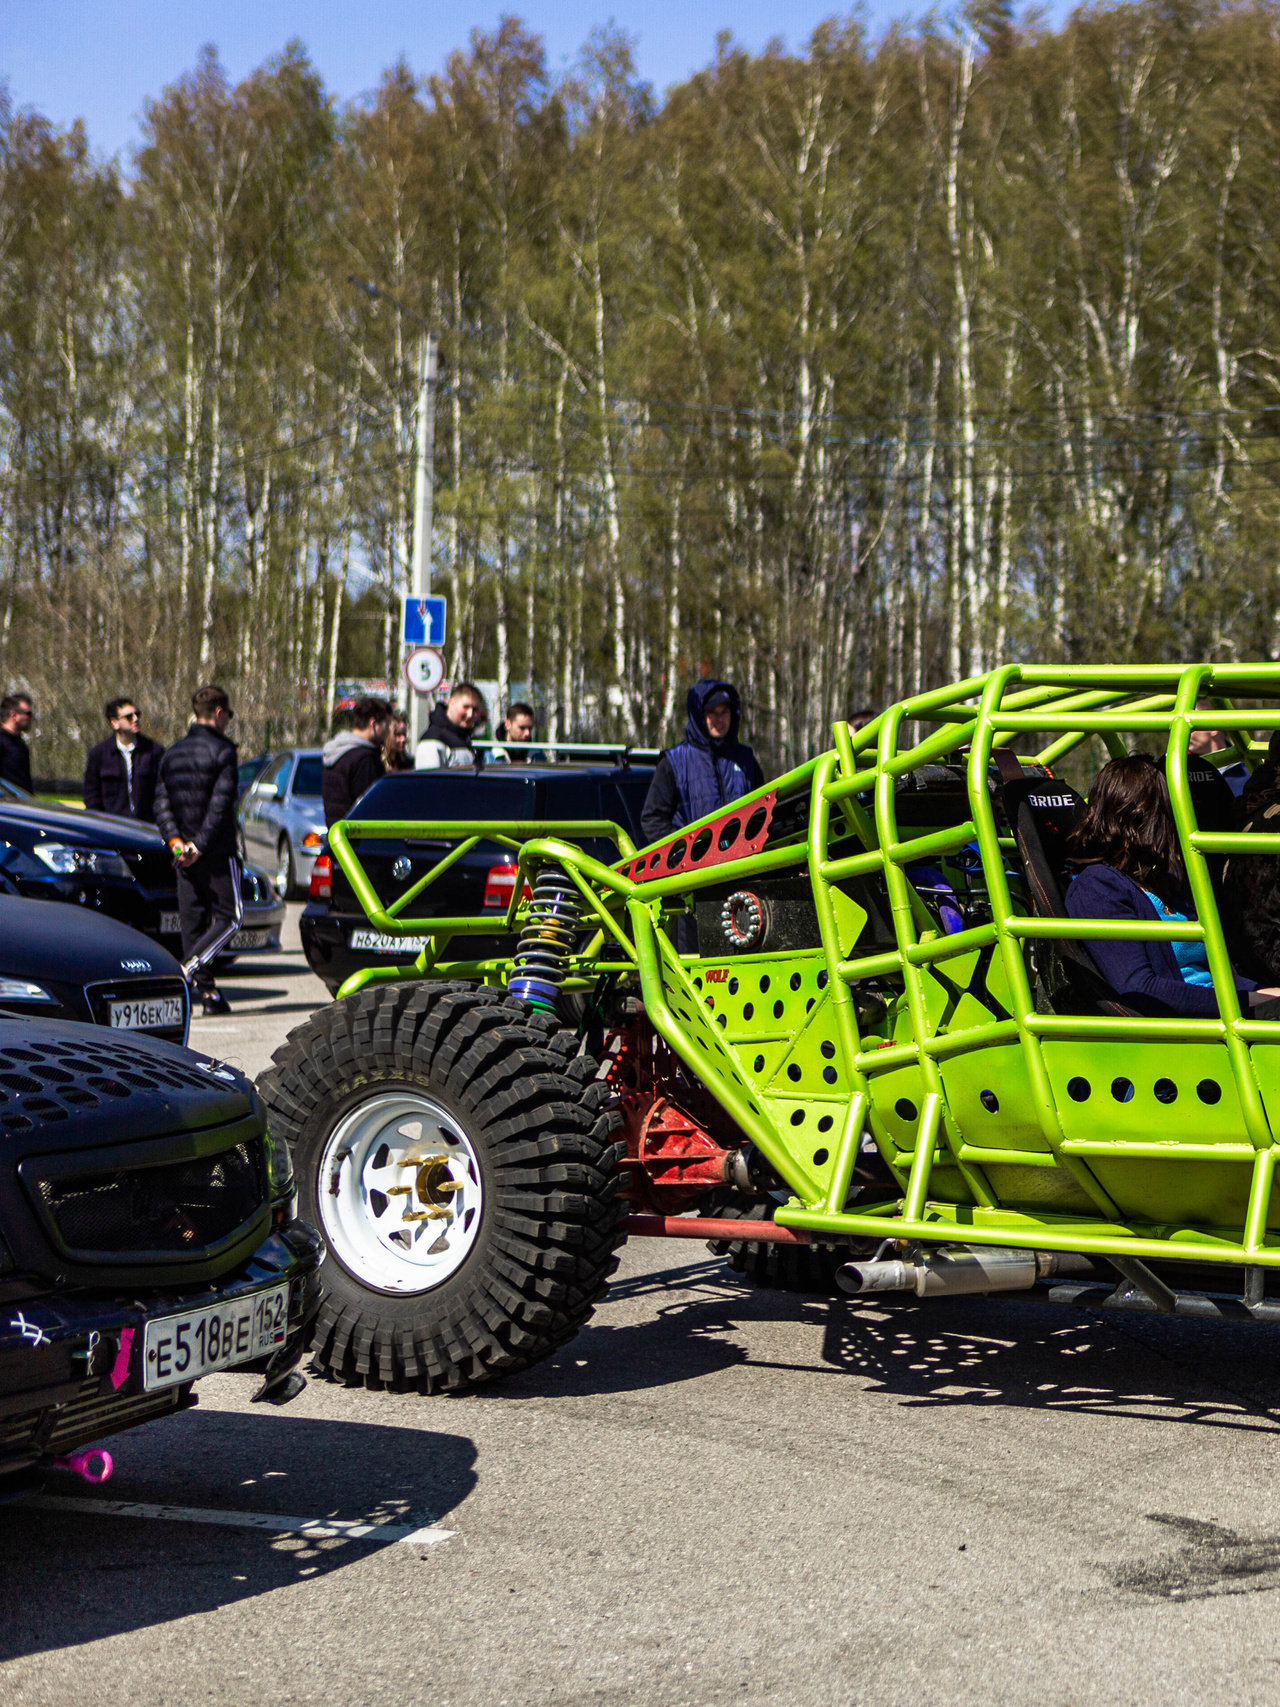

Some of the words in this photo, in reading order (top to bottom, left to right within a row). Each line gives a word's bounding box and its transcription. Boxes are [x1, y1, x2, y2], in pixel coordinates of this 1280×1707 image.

[421, 661, 431, 680] 5
[1187, 770, 1214, 782] RIDE
[1028, 794, 1075, 807] BRIDE
[705, 969, 730, 984] WOLF
[333, 1068, 430, 1101] MAXXIS
[256, 1293, 283, 1333] 152
[259, 1332, 274, 1347] RUS
